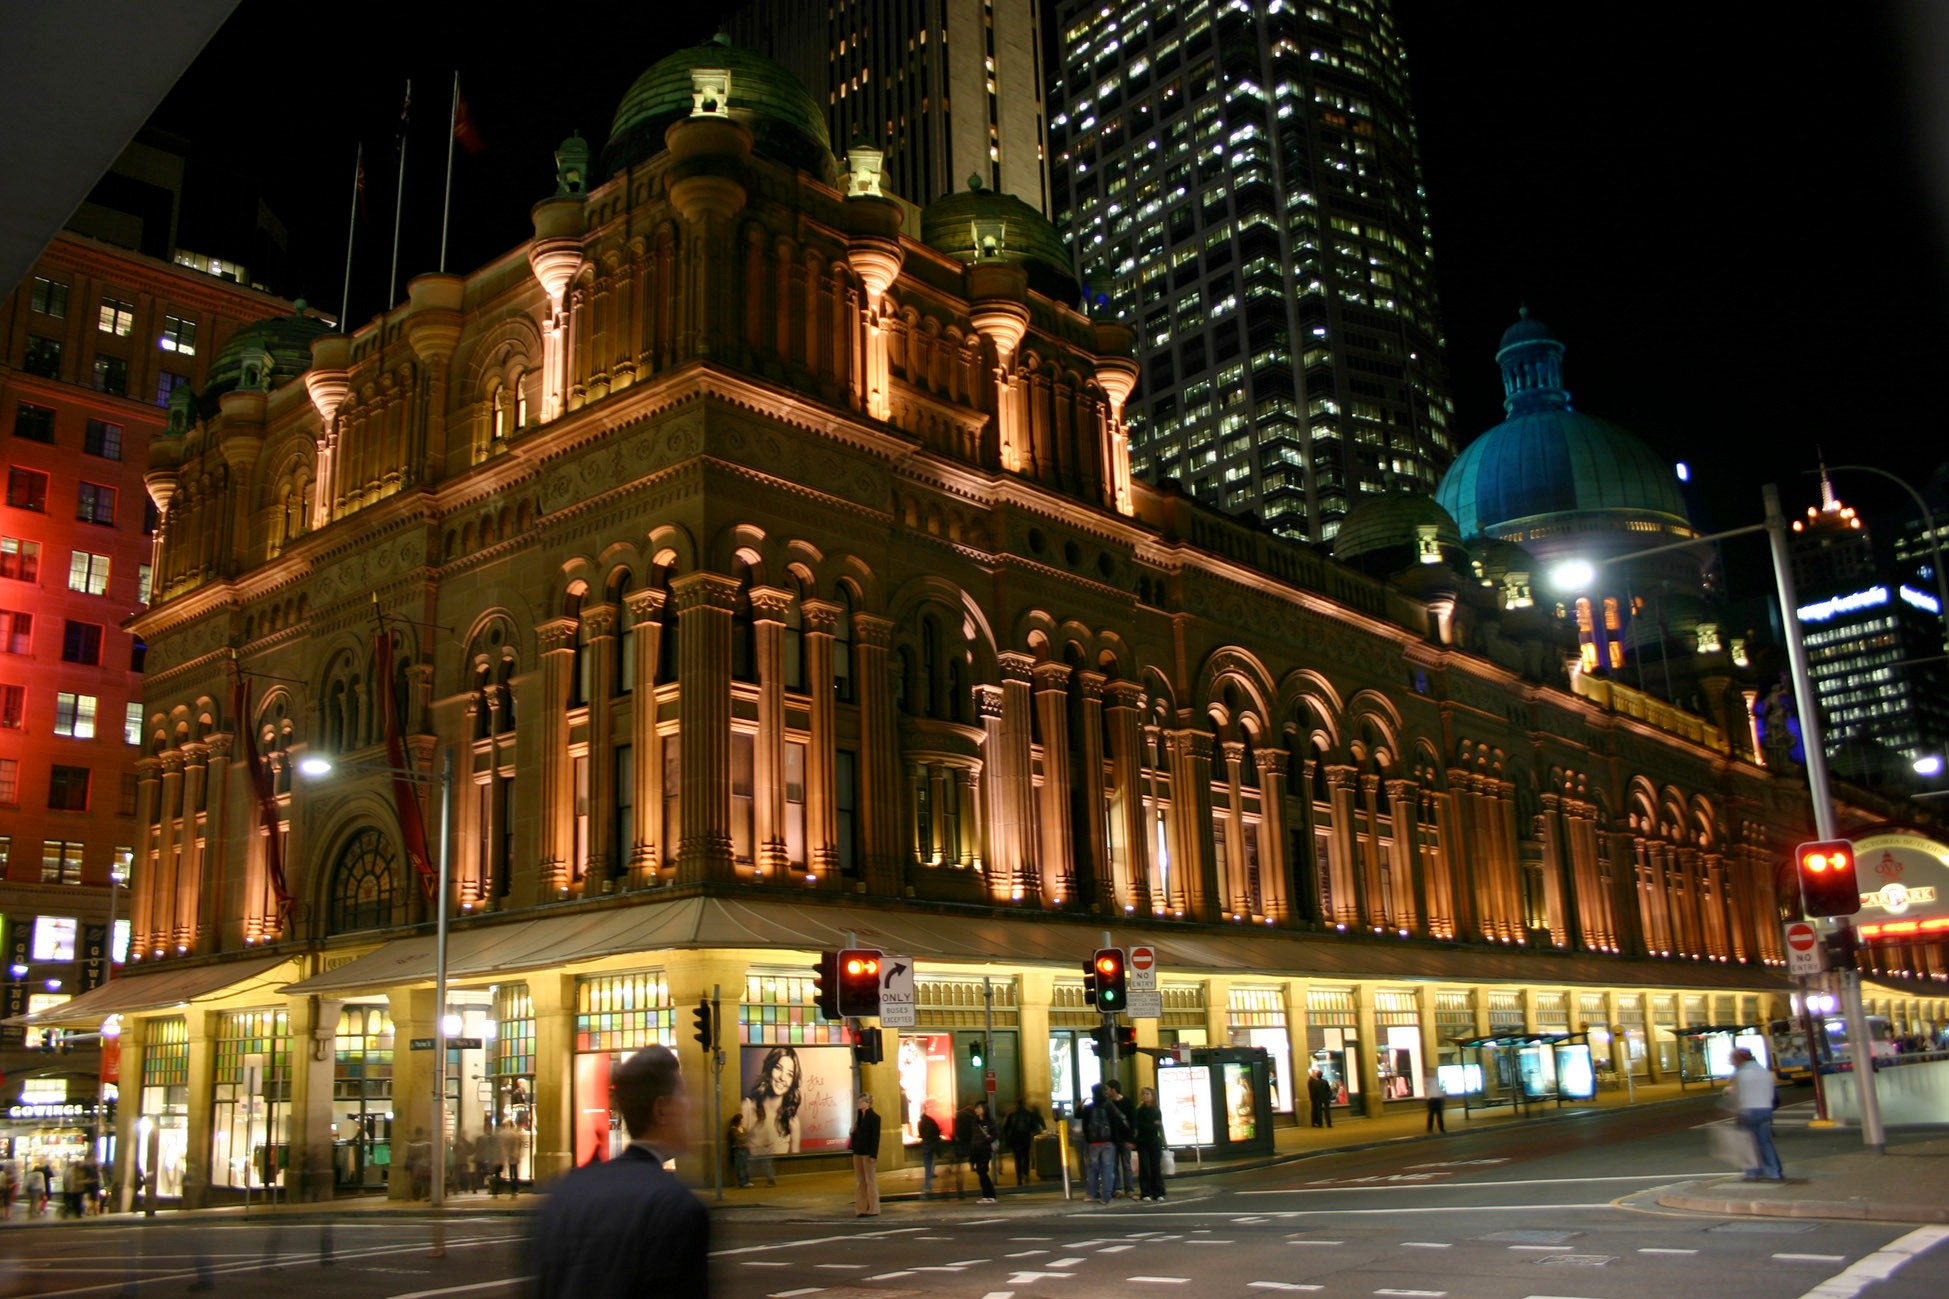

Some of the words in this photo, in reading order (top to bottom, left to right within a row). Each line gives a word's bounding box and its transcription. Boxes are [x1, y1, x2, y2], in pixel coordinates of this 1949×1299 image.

[1796, 953, 1812, 962] NO
[1791, 963, 1818, 971] ENTRY
[882, 993, 912, 1002] ONLY
[10, 1104, 83, 1118] GOWINGS
